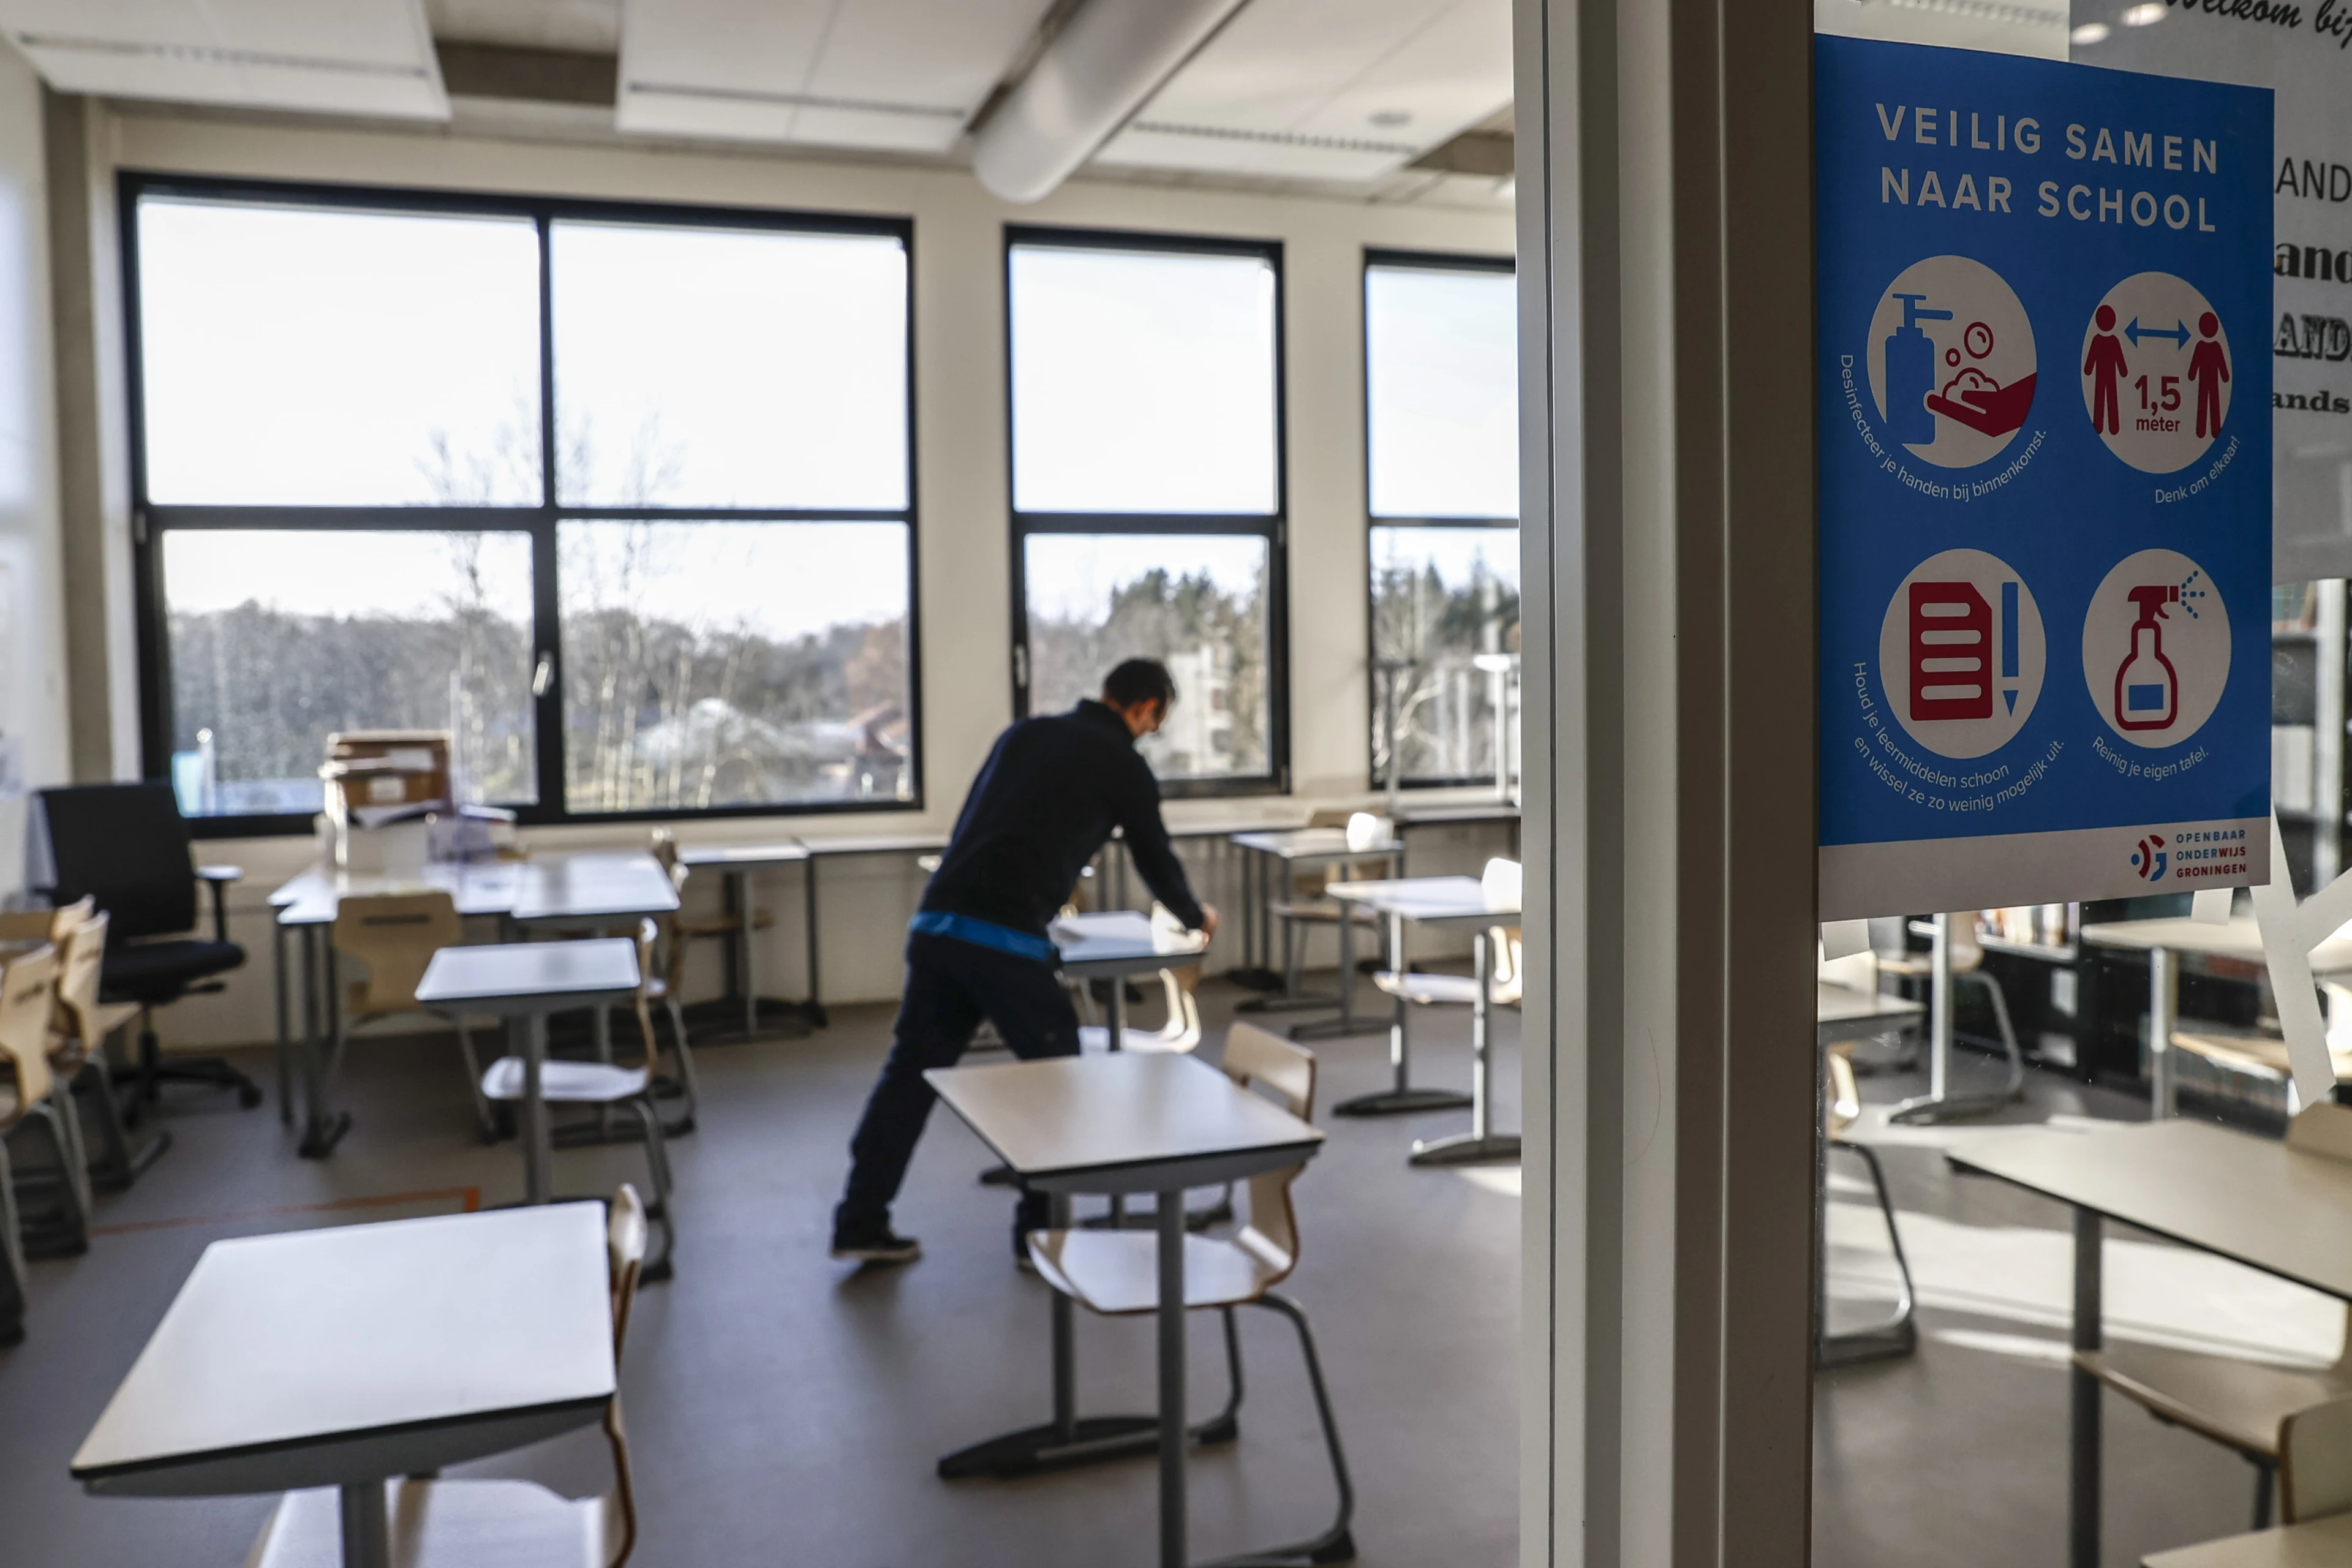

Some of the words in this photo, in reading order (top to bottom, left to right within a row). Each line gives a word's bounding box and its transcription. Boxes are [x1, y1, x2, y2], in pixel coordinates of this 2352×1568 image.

[1875, 103, 2041, 154] VEILIG
[2065, 123, 2217, 174] SAMEN
[1882, 167, 2013, 214] NAAR
[2038, 181, 2215, 232] SCHOOL
[2135, 375, 2181, 417] 1,5
[1841, 354, 1885, 458] Desinfecteer
[1880, 454, 1896, 473] je
[1898, 466, 1949, 499] handen
[1953, 484, 1970, 502] bij
[1972, 430, 2046, 497] binnenkomst.
[2136, 417, 2180, 432] meter
[2155, 486, 2188, 503] Denk
[2190, 476, 2209, 494] om
[2209, 435, 2241, 480] elkaar!
[1854, 662, 1874, 709] Houd
[1863, 710, 1879, 728] je
[1855, 737, 1871, 758] en
[1869, 756, 1909, 795] wissel
[1908, 788, 1925, 804] ze
[1928, 796, 1945, 810] zo
[1948, 794, 1994, 812] weinig
[1997, 760, 2048, 804] mogelijk
[2046, 741, 2064, 761] uit.
[1875, 726, 1956, 788] leermiddelen
[1960, 765, 2010, 788] schoon
[2092, 736, 2128, 774] Reinig
[2128, 760, 2141, 777] je
[2143, 764, 2177, 782] eigen
[2179, 745, 2209, 771] tafel.
[2176, 829, 2245, 843] OPENBAAR
[2176, 846, 2246, 861] ONDERWIJS
[2177, 864, 2247, 878] GRONINGEN
